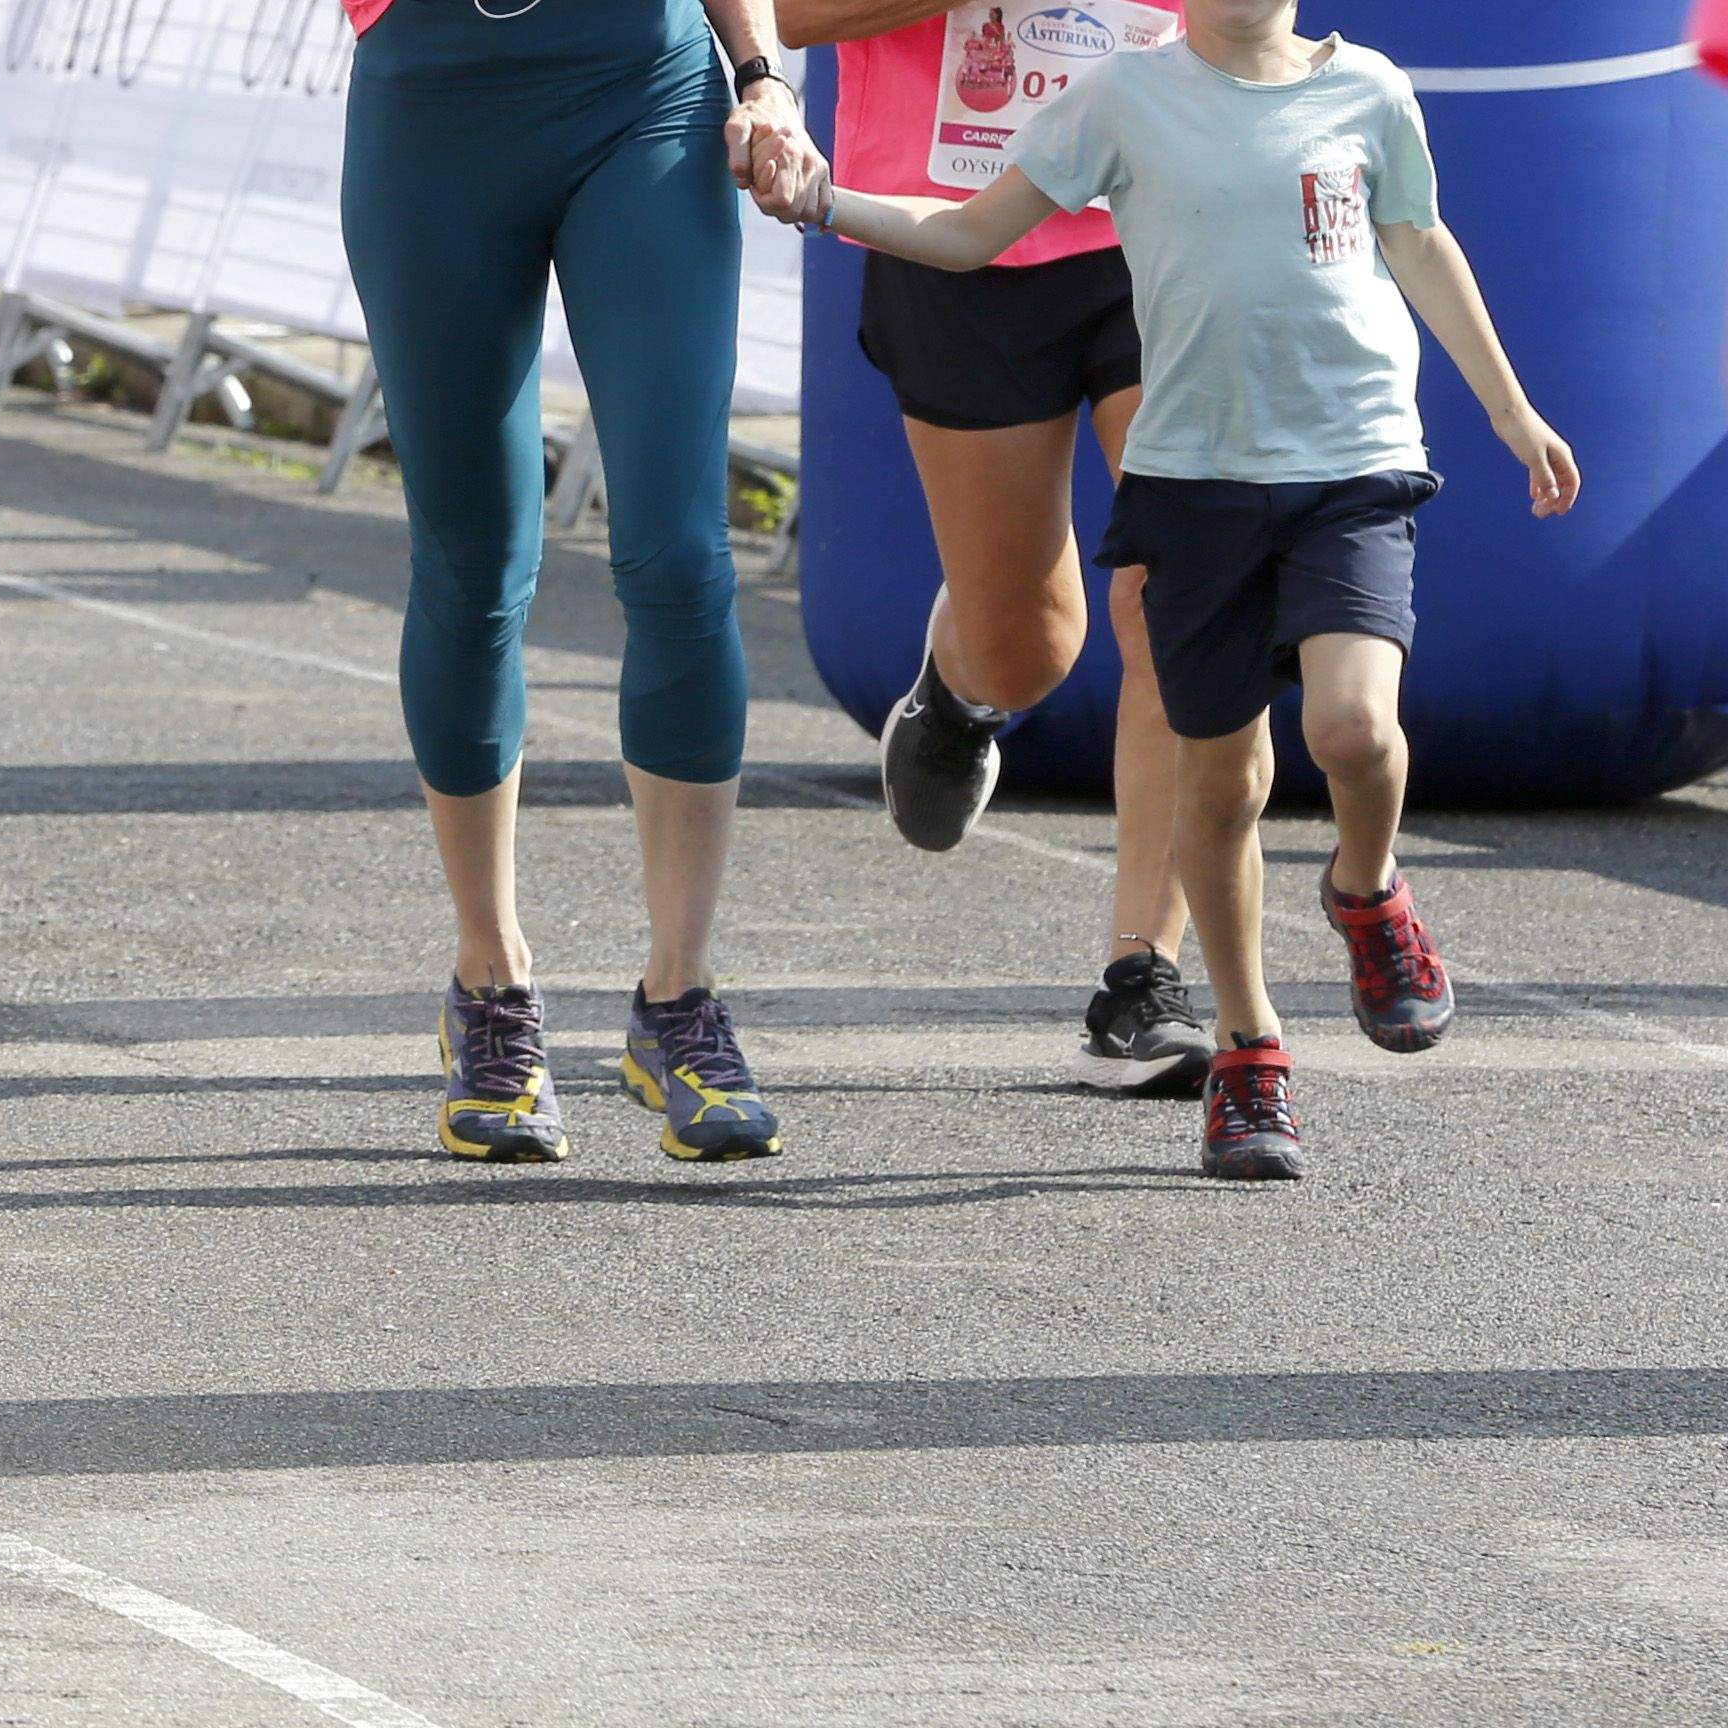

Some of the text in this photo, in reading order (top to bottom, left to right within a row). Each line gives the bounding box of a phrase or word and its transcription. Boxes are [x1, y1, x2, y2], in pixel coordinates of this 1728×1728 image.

[1025, 22, 1108, 51] ASTURIANA
[1123, 31, 1160, 48] SUMA
[1023, 71, 1069, 99] 01
[962, 130, 1010, 143] CARRE
[952, 156, 1005, 175] OYSH
